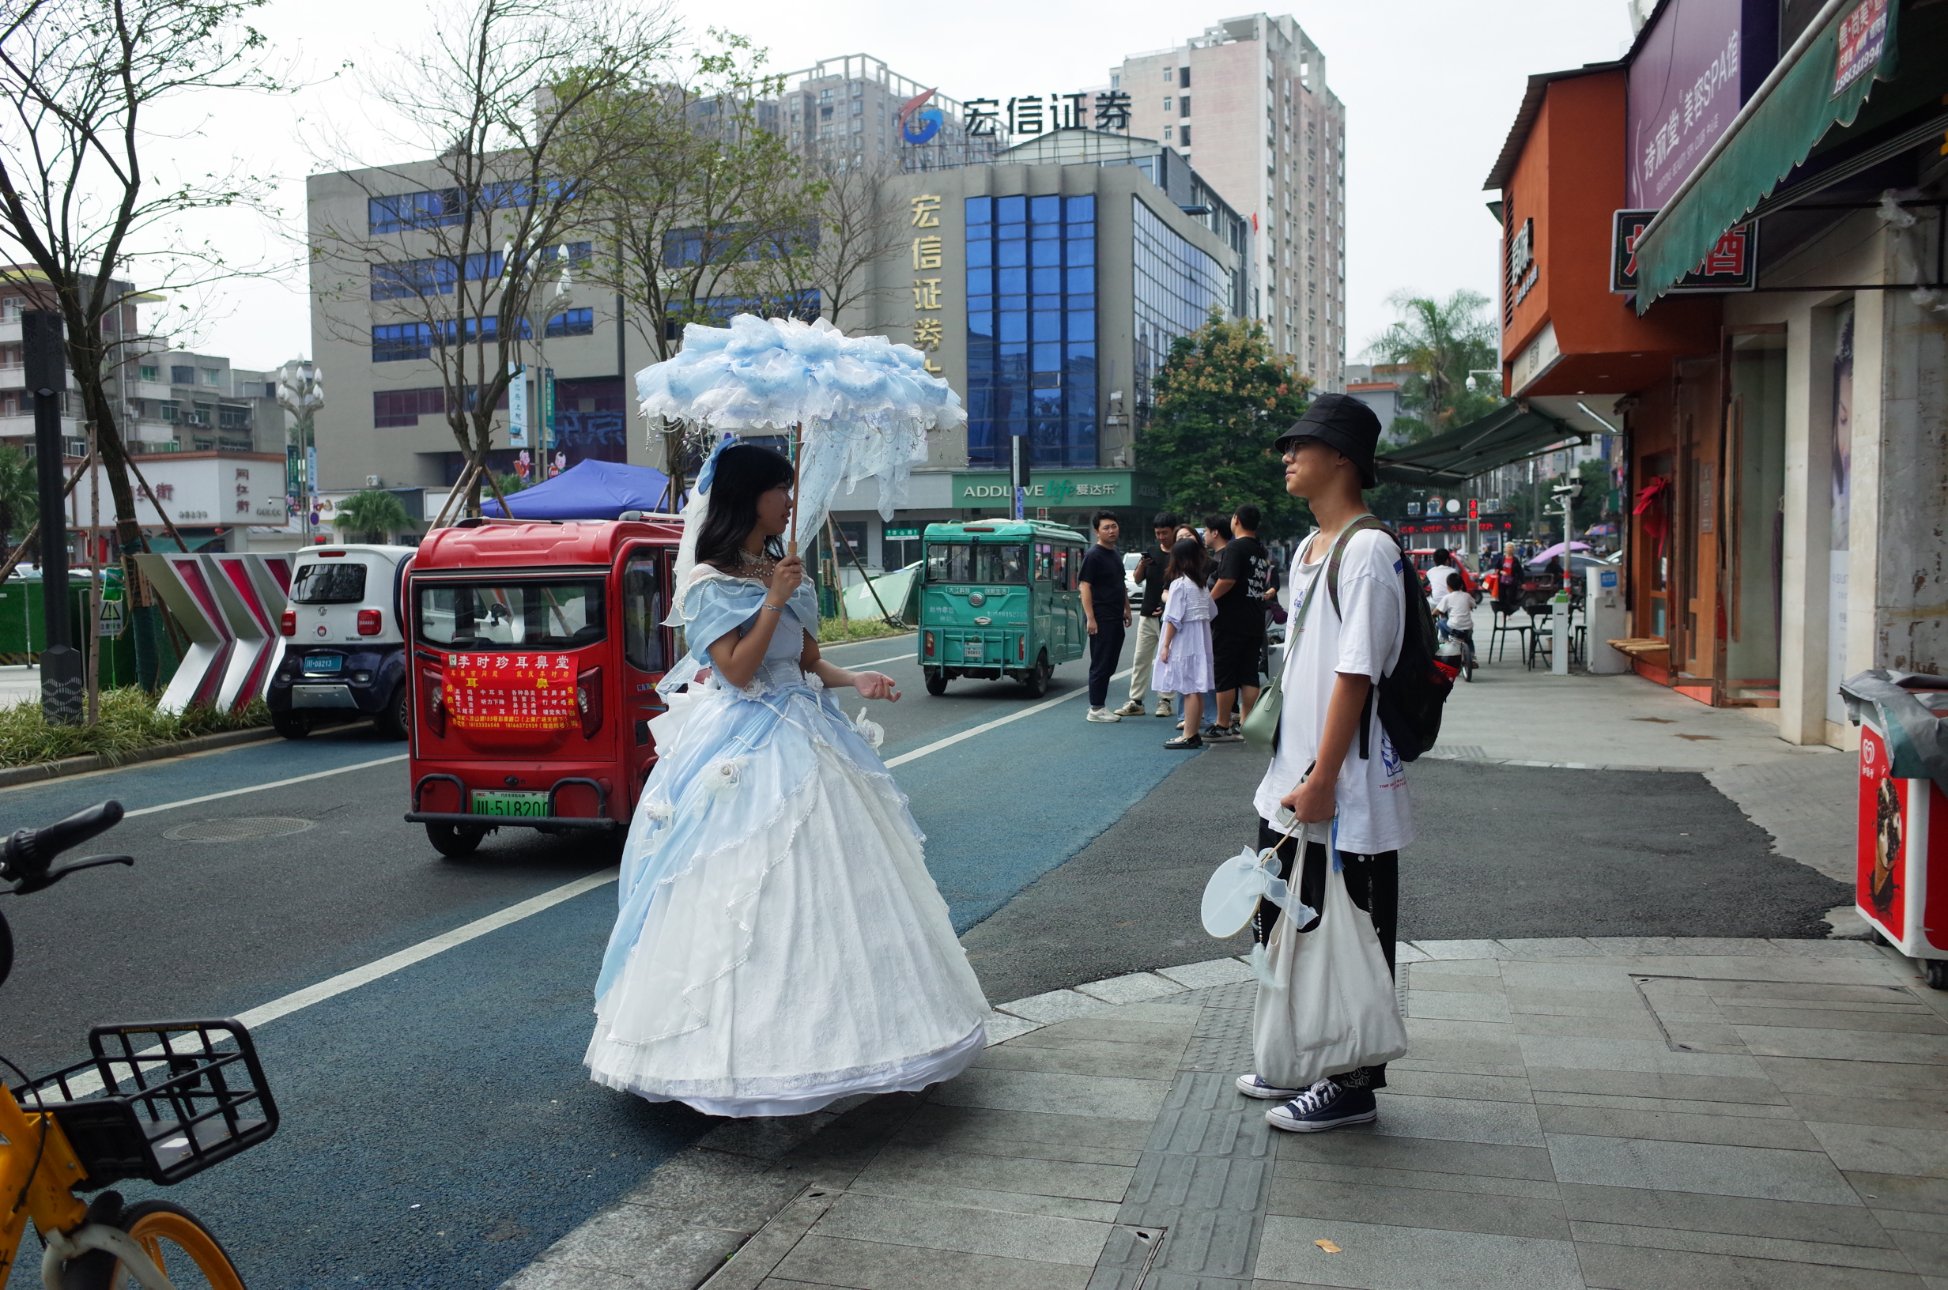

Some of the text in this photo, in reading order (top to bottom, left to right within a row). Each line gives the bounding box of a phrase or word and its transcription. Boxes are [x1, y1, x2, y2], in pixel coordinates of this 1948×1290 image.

[1684, 29, 1738, 136] 美容SPA馆
[963, 91, 1132, 137] 宏信证券
[235, 468, 250, 514] 网红街
[964, 485, 1044, 498] ADDLVE
[1076, 484, 1115, 496] 爱达乐
[458, 655, 570, 669] 李时珍耳鼻堂
[466, 677, 479, 688] 耳
